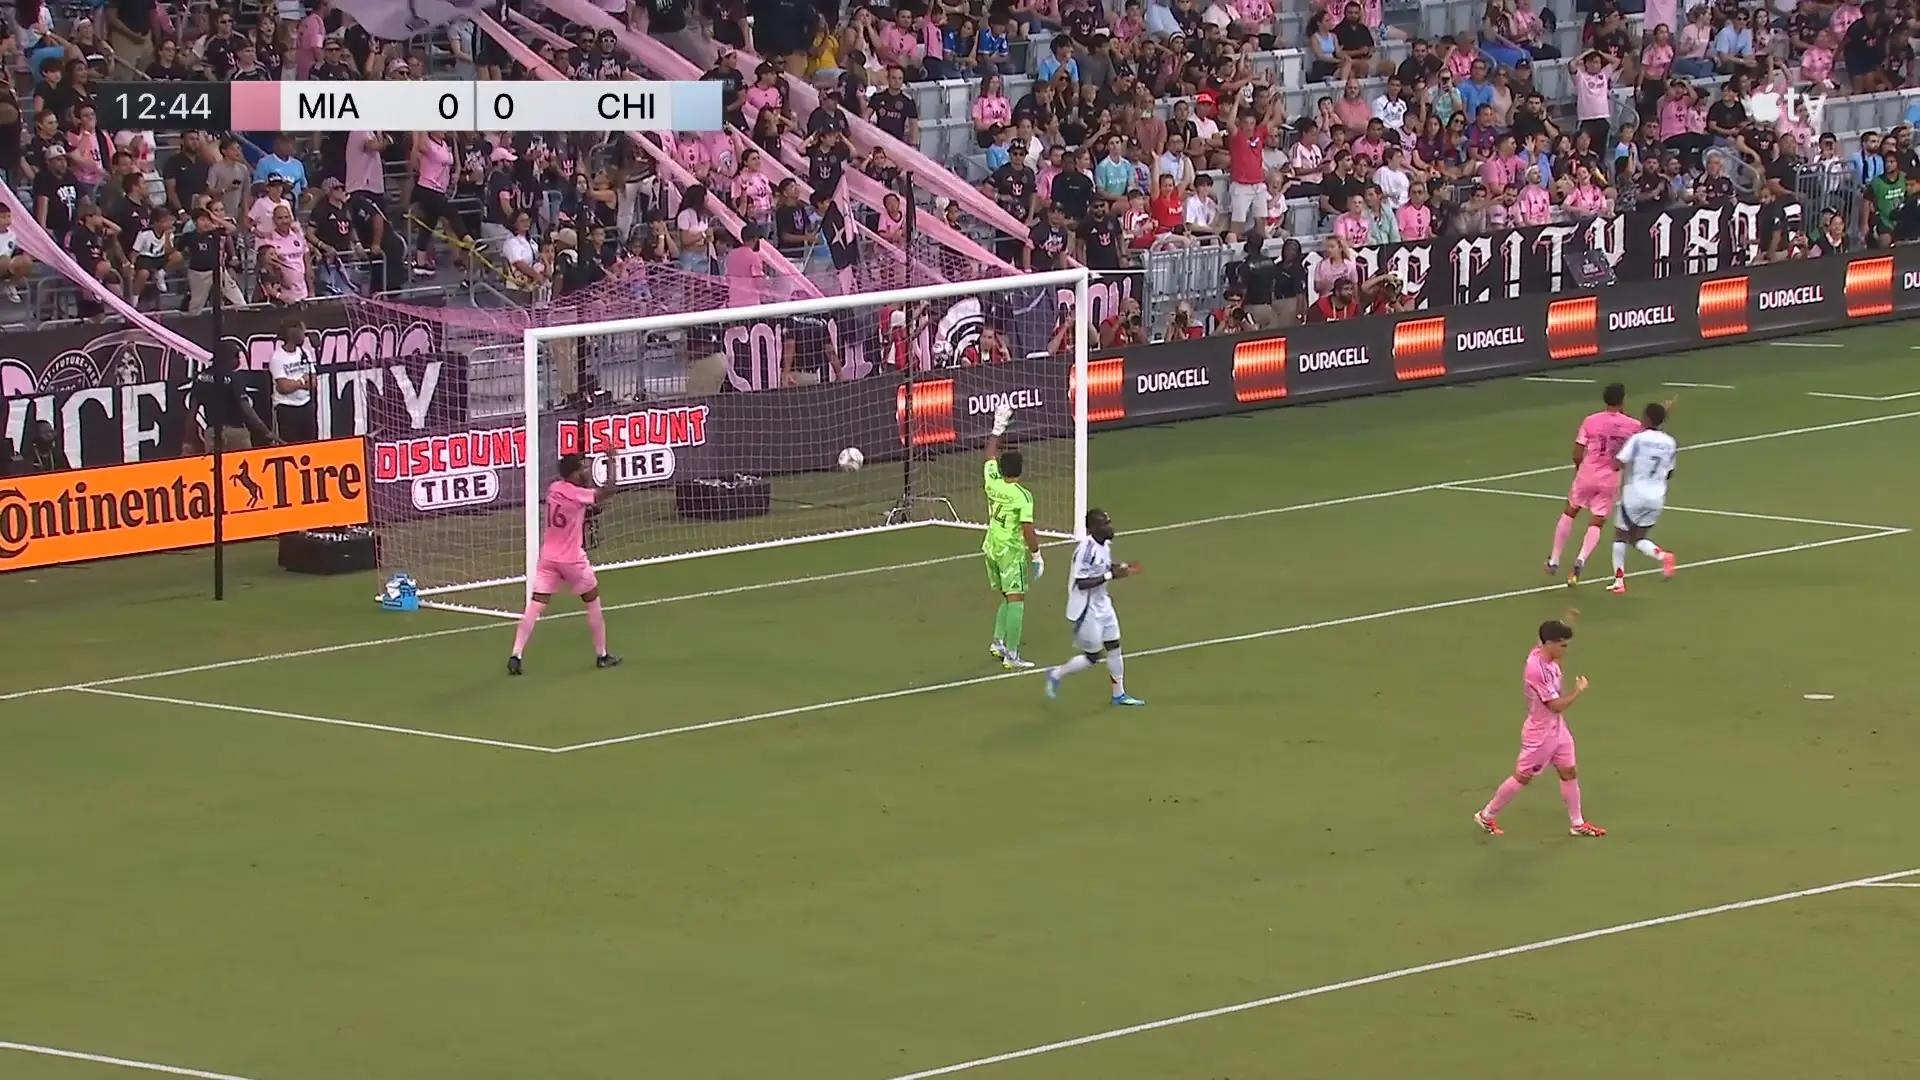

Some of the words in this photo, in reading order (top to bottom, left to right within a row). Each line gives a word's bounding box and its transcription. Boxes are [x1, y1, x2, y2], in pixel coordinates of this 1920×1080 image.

[1759, 285, 1824, 310] DURACELL
[1609, 305, 1675, 331] DURACELL
[1457, 326, 1525, 351] DURACELL
[55, 356, 86, 371] FUTURE
[1299, 346, 1370, 373] DURACELL
[1137, 367, 1210, 394] DURACELL
[968, 389, 1043, 415] DURACELL
[558, 406, 706, 458] DISCOUNT
[1649, 455, 1663, 479] 7
[262, 456, 361, 510] Tire
[420, 474, 489, 502] TIRE
[547, 503, 567, 528] 16
